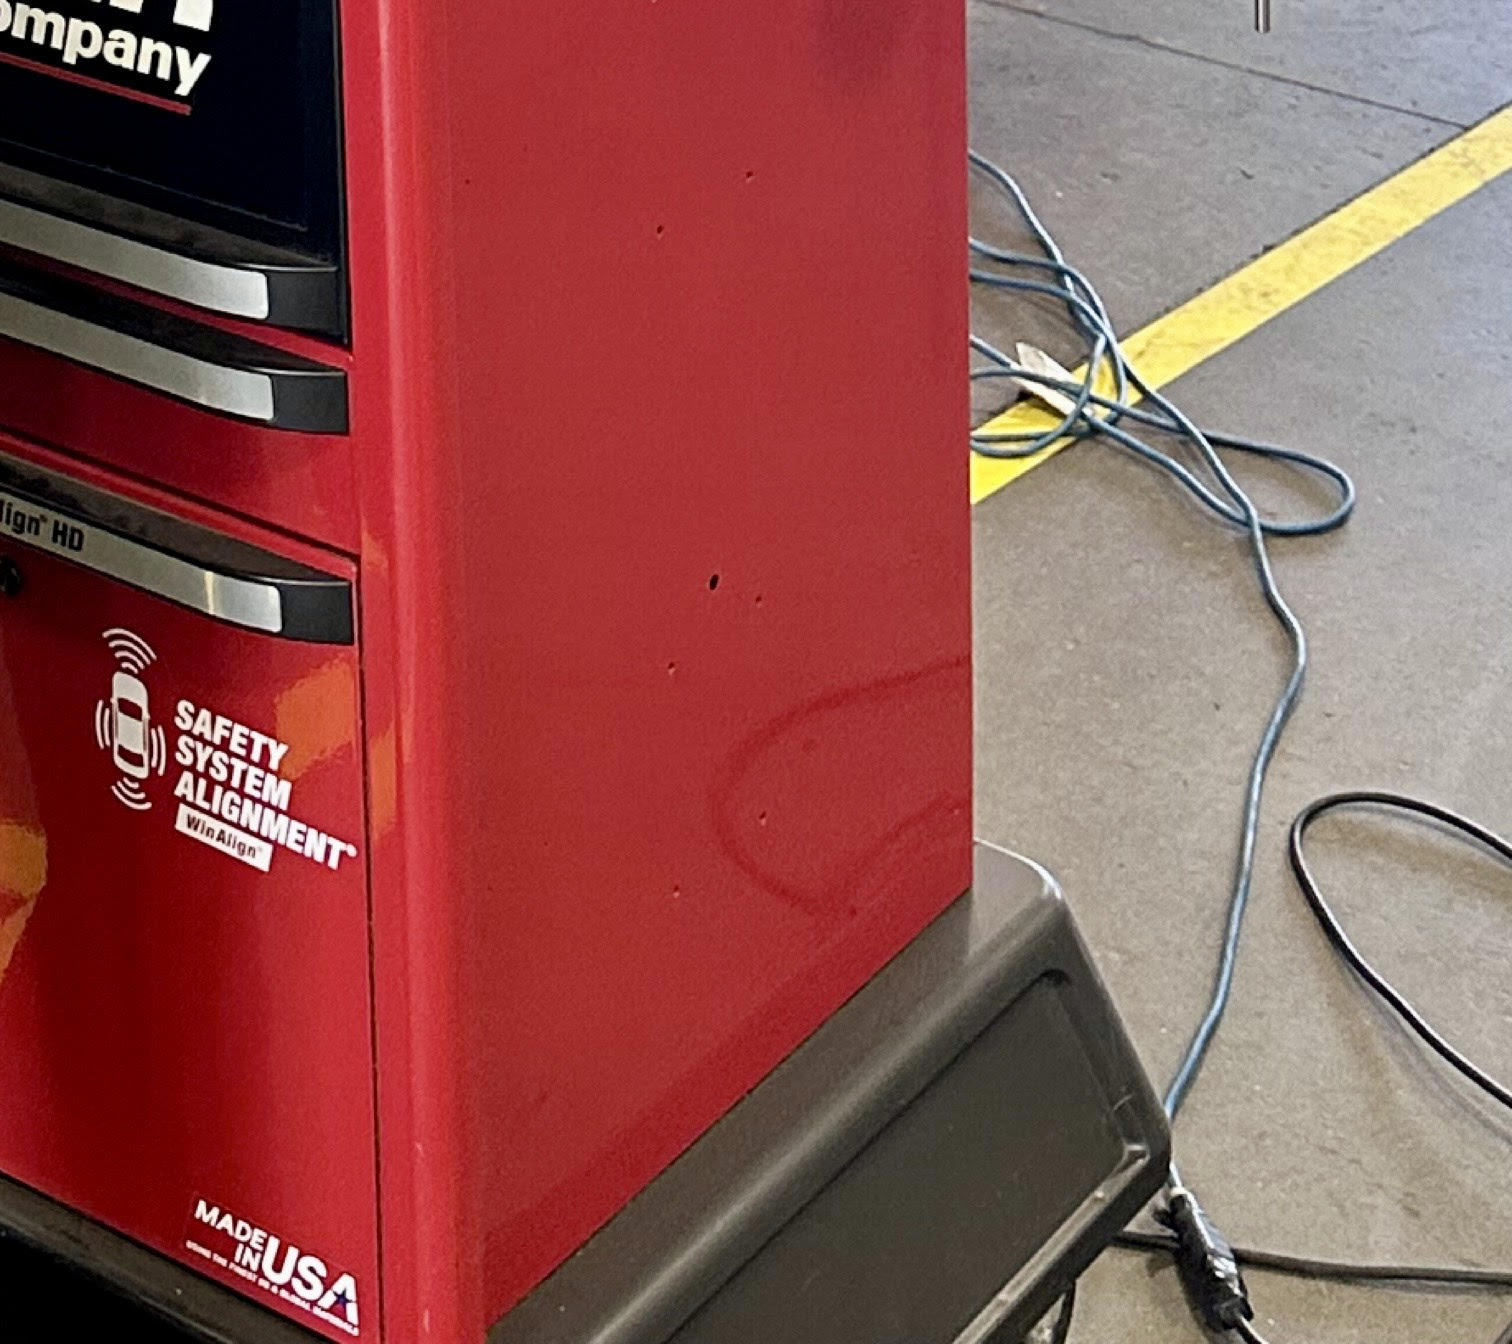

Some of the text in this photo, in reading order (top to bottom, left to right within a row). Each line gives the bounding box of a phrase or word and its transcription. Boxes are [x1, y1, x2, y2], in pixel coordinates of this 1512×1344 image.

[52, 520, 84, 552] HD
[174, 699, 289, 772] SAFETY
[175, 734, 293, 811] SYSTEM
[194, 1199, 267, 1251] MADE
[234, 1235, 360, 1327] IN USA
